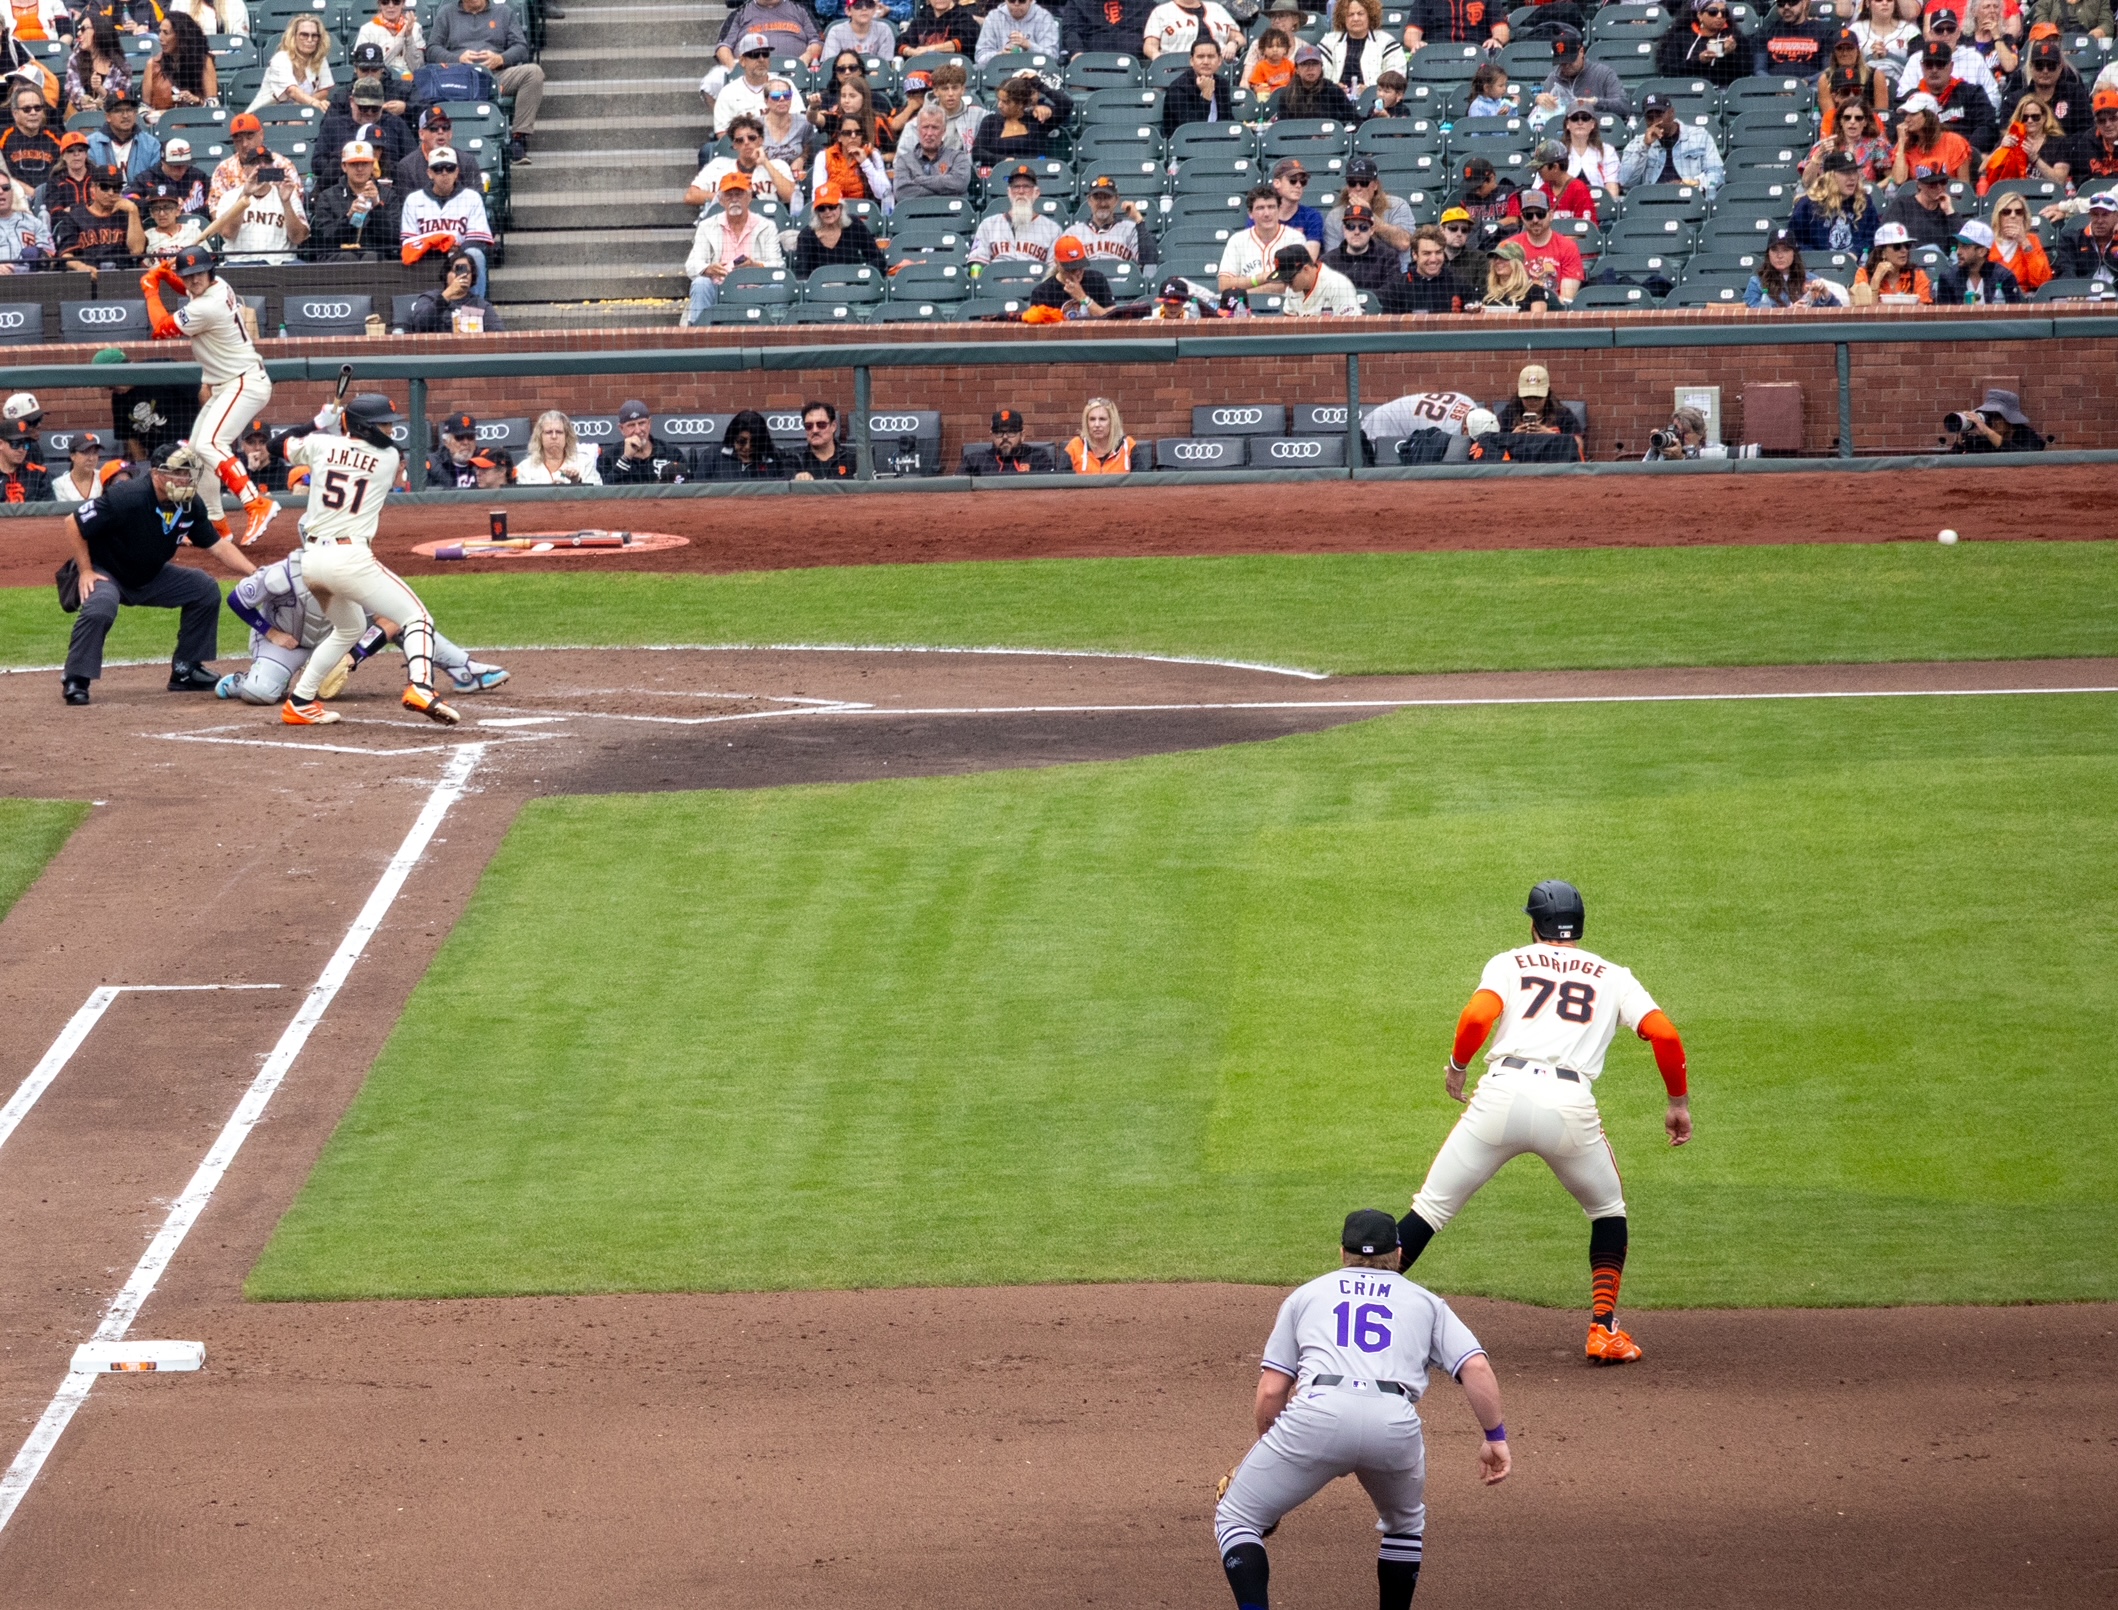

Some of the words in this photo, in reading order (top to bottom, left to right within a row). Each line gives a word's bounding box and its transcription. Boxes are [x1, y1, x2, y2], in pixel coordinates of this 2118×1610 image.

[1164, 18, 1231, 36] GIANT
[322, 469, 369, 515] 51
[78, 499, 98, 524] 51
[1514, 953, 1607, 979] ELDRIDGE
[1520, 975, 1597, 1026] 78
[1339, 1279, 1392, 1298] CRIM
[1333, 1301, 1394, 1354] 16
